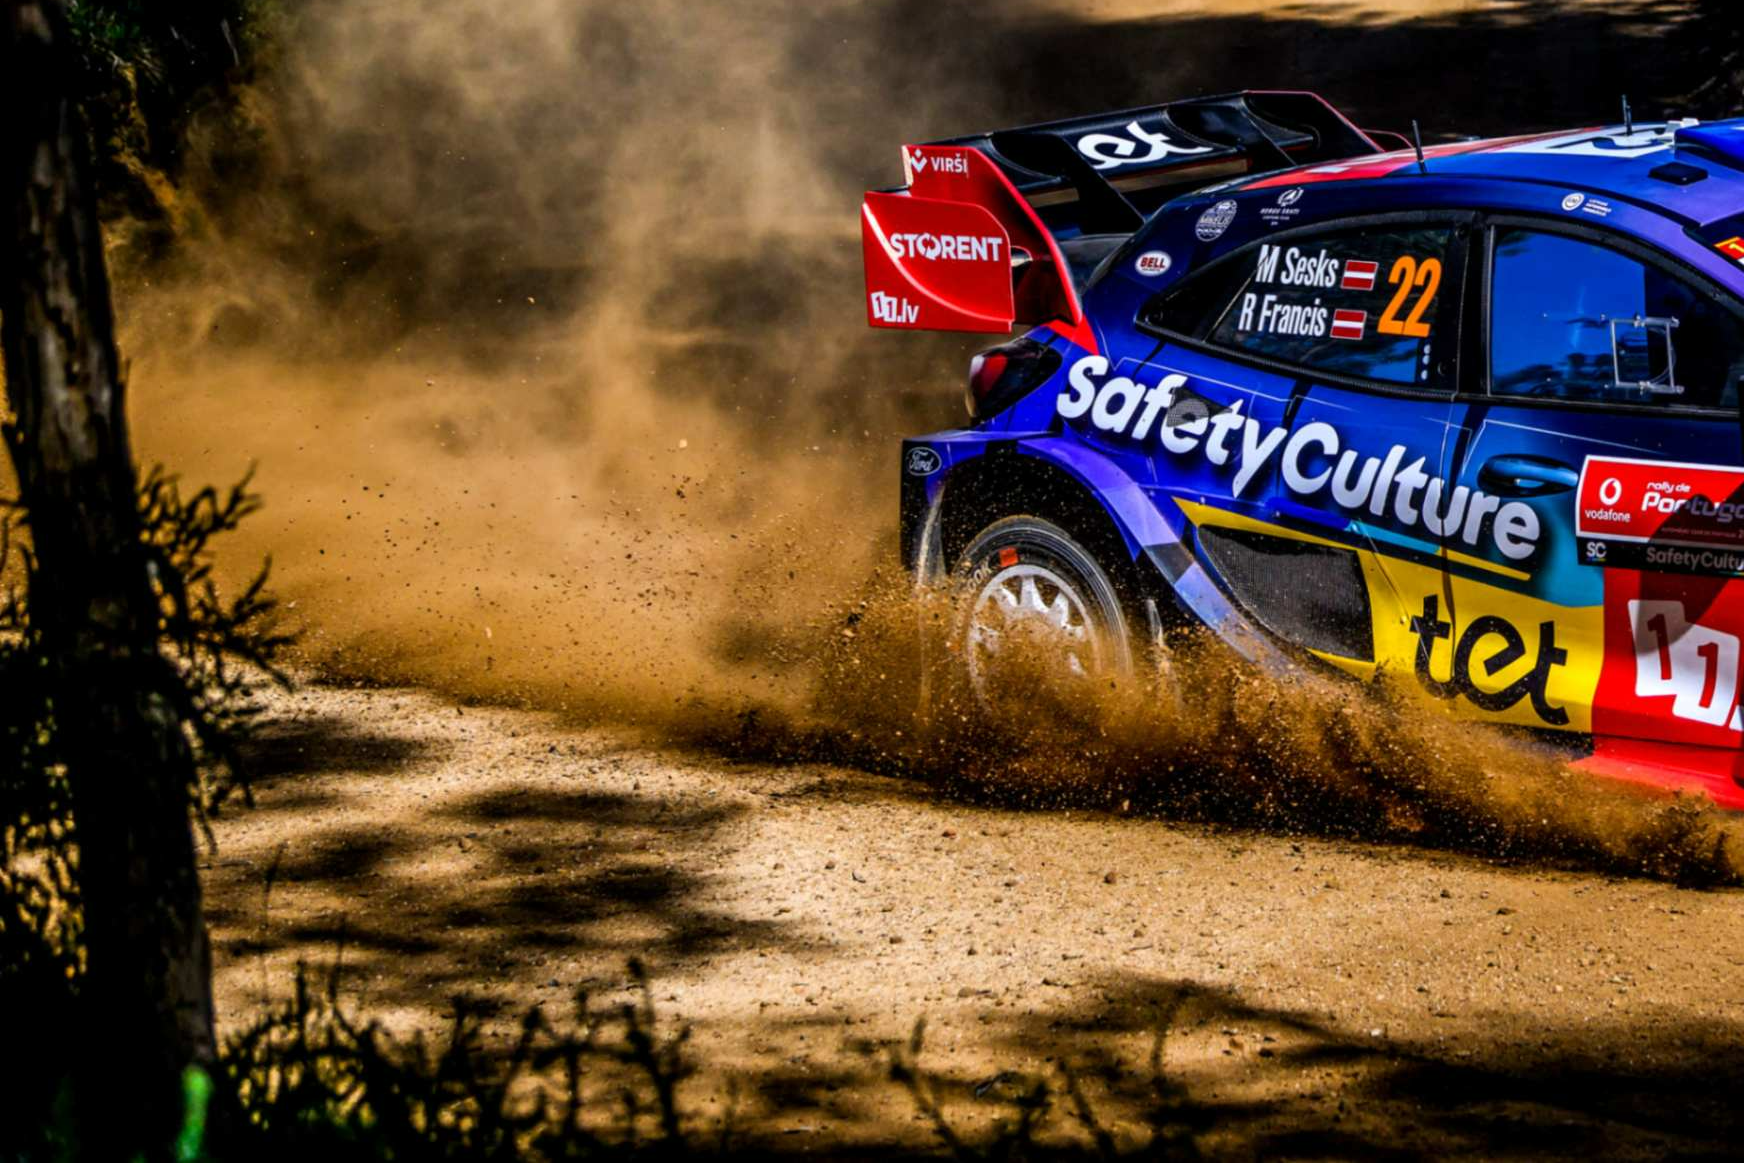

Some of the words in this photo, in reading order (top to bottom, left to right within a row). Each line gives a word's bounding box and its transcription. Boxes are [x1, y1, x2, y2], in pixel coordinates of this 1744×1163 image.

[930, 153, 968, 173] VIRŠI
[890, 232, 1003, 262] STORENT
[1140, 256, 1165, 269] BELL
[1255, 244, 1281, 283] M
[1280, 246, 1340, 288] Sesks
[1377, 255, 1442, 338] 22
[1237, 293, 1257, 331] R
[1257, 294, 1328, 337] Francis
[1056, 355, 1540, 560] SafetyCulture
[1646, 481, 1674, 494] rally
[1674, 483, 1691, 493] de
[1584, 508, 1631, 523] vodafone
[1586, 542, 1607, 559] SC
[1408, 595, 1570, 726] tet
